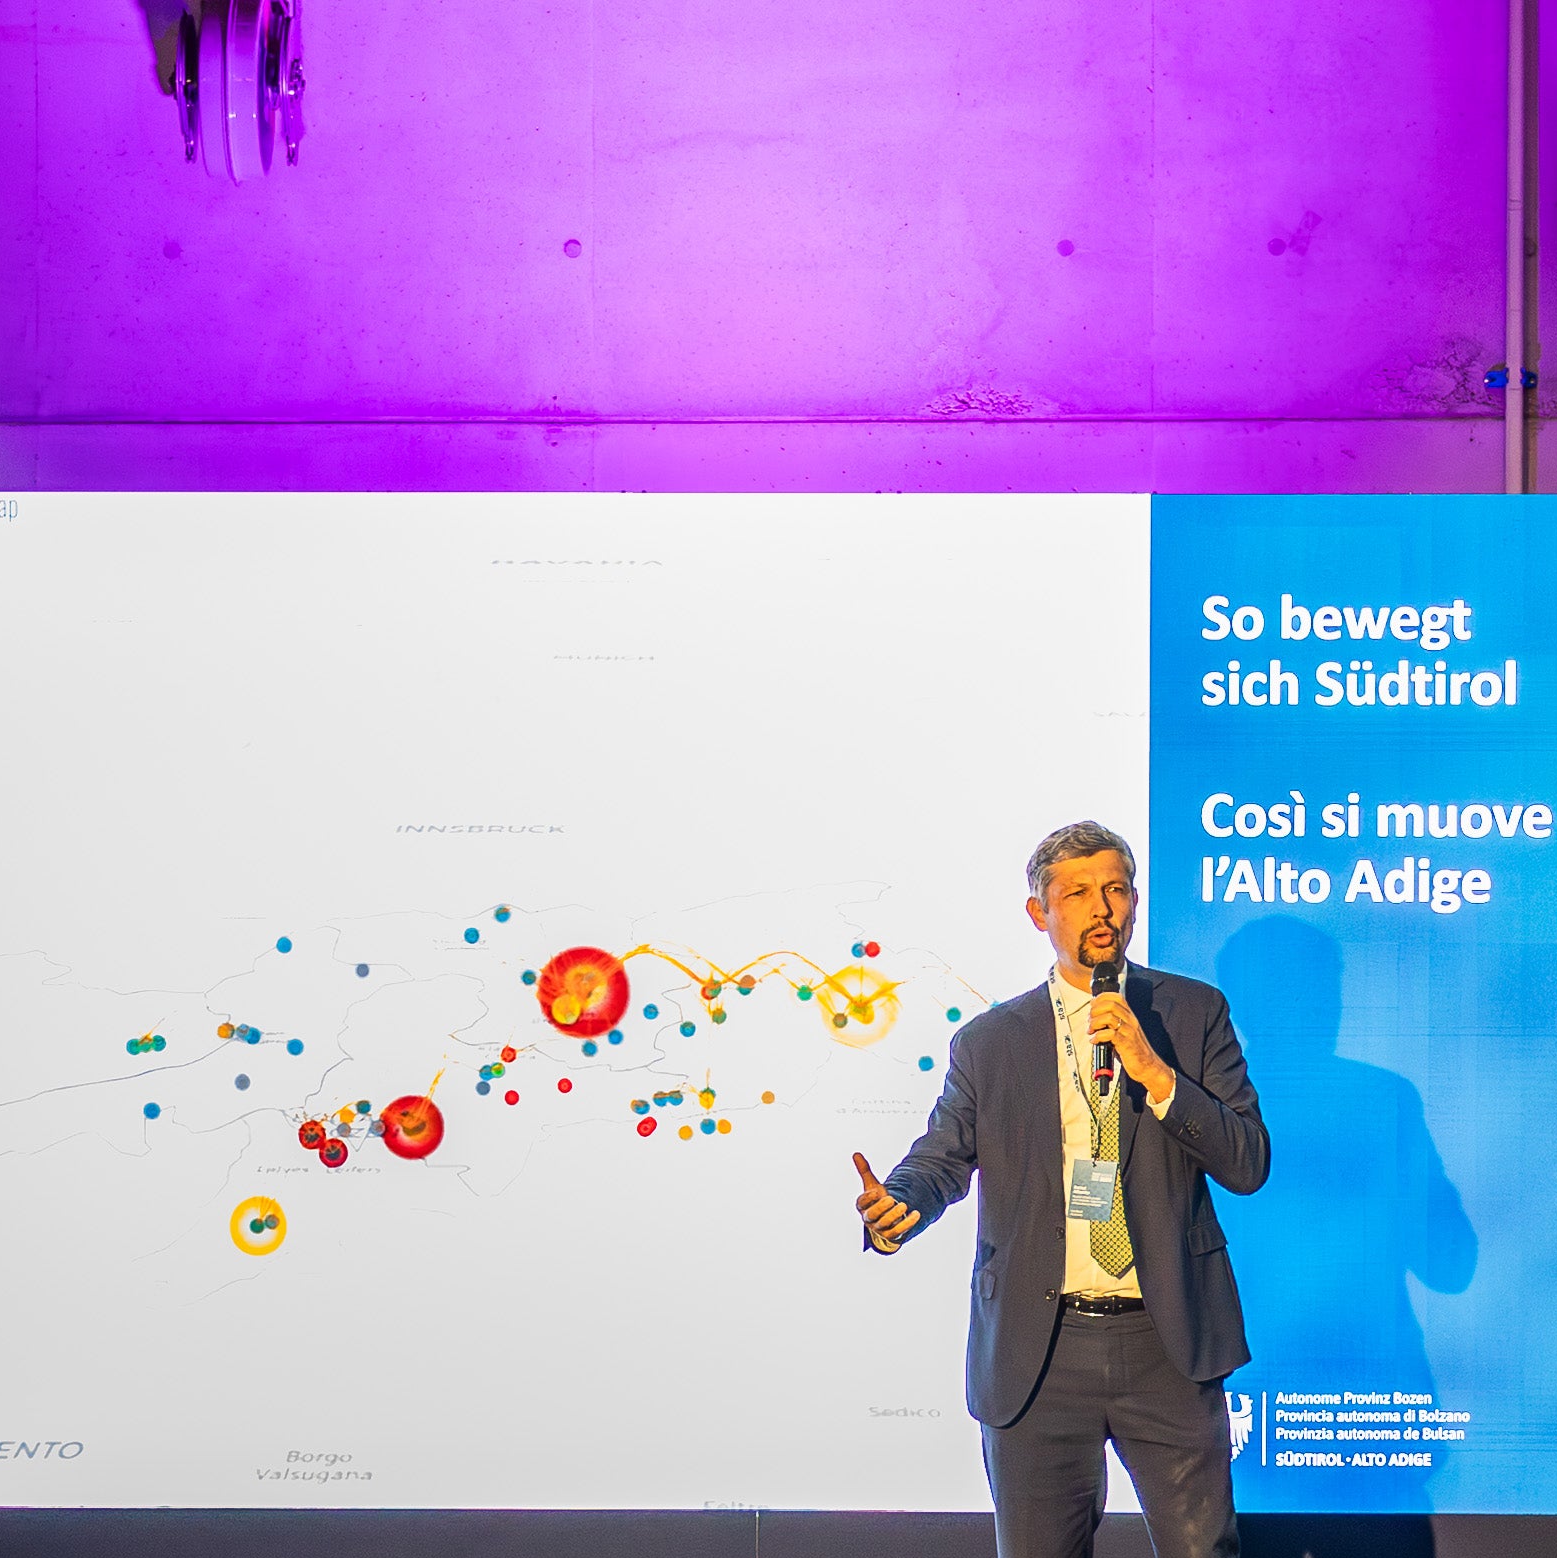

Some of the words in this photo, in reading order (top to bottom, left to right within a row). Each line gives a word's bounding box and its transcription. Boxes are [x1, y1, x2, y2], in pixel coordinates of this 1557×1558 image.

[1202, 596, 1264, 641] So
[1281, 594, 1472, 651] bewegt
[1202, 660, 1299, 706] sich
[1315, 659, 1517, 707] Südtirol
[1202, 791, 1306, 838] Così
[1322, 793, 1360, 838] si
[1377, 804, 1553, 838] muove
[395, 825, 565, 834] INNSBRUCK
[1202, 856, 1331, 904] l’Alto
[1345, 857, 1492, 914] Adige
[1275, 1392, 1342, 1405] Autonome
[1344, 1392, 1391, 1405] Provinz
[1393, 1392, 1433, 1405] Bozen
[1275, 1409, 1334, 1423] Provincia
[1336, 1411, 1401, 1423] autonoma
[1403, 1409, 1416, 1423] di
[1418, 1409, 1471, 1423] Bolzano
[1275, 1427, 1334, 1440] Provinzia
[1336, 1428, 1401, 1440] autonoma
[1403, 1427, 1420, 1440] de
[1422, 1427, 1465, 1440] Bulsan
[286, 1450, 353, 1467] Borgo
[1275, 1451, 1344, 1467] SÜDTIROL
[1352, 1453, 1386, 1467] ALTO
[1388, 1453, 1432, 1467] ADIGE
[256, 1468, 373, 1484] Valsugana
